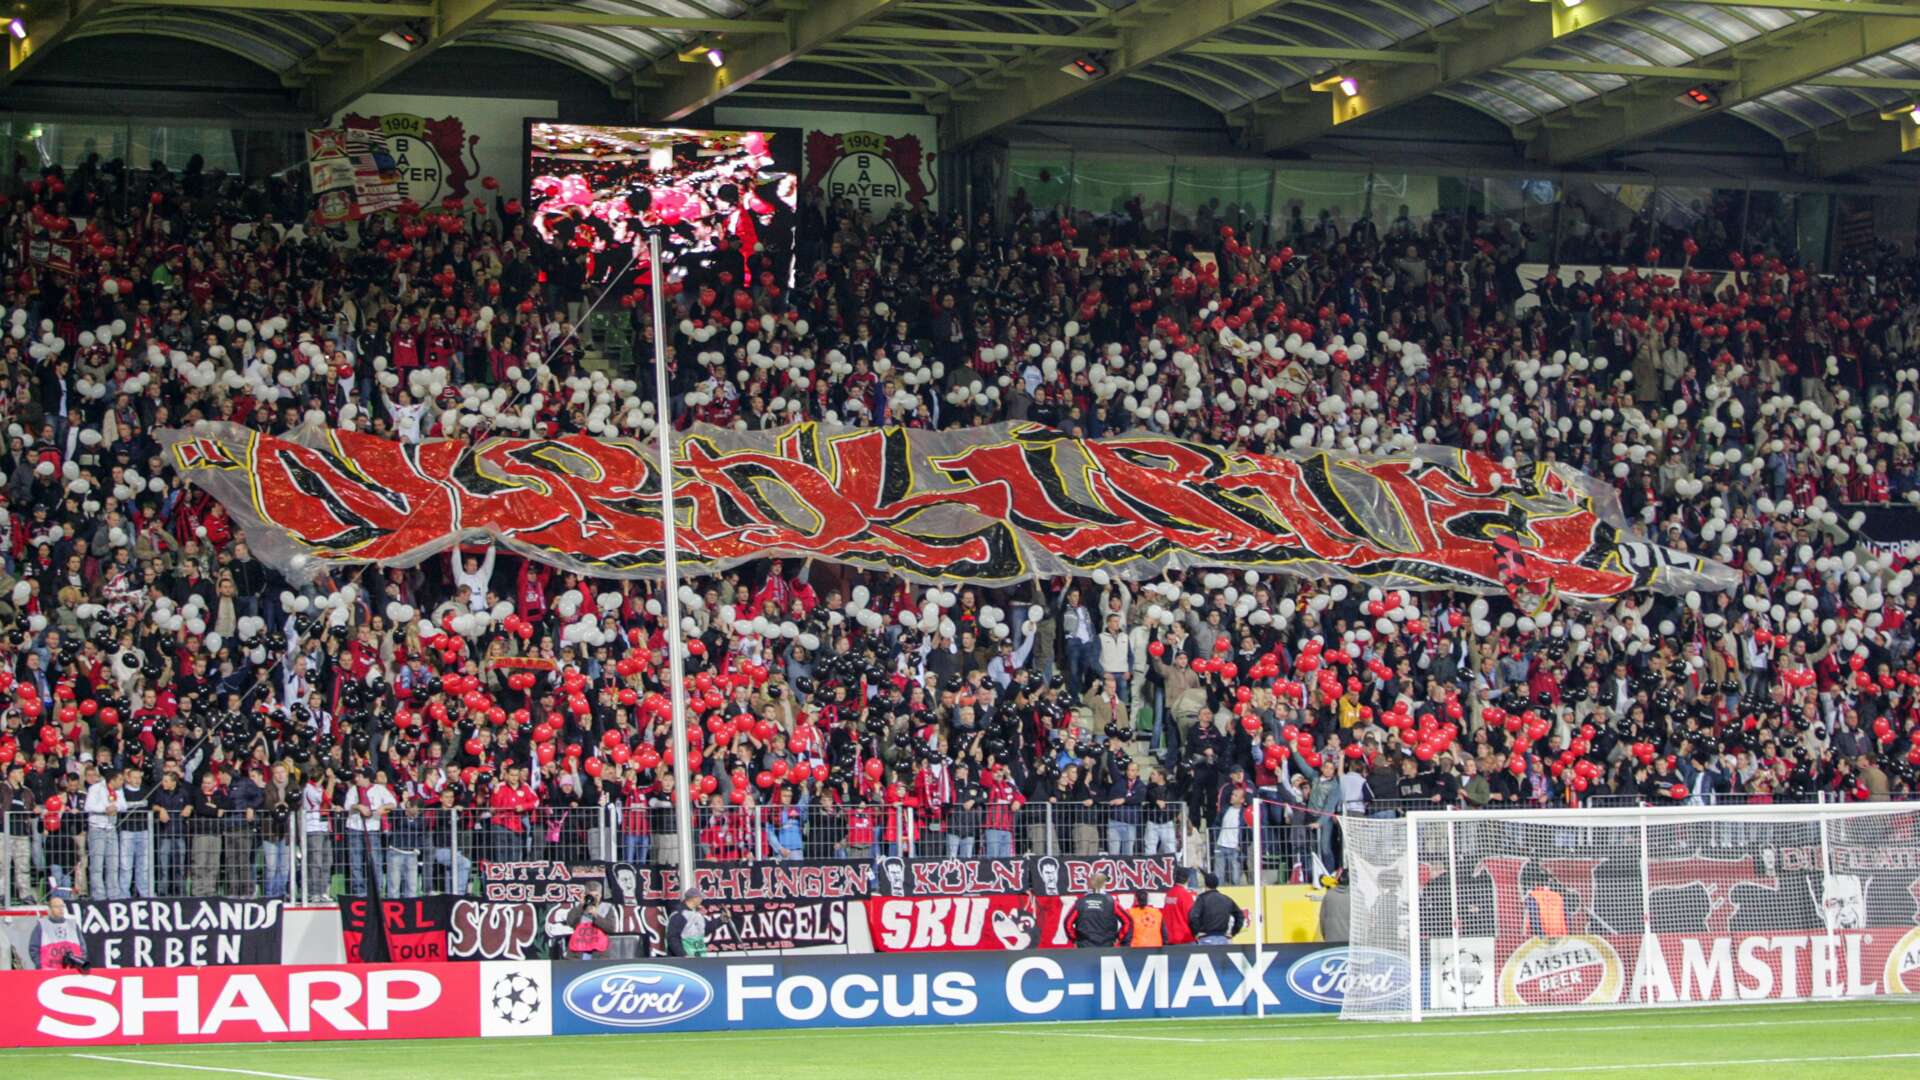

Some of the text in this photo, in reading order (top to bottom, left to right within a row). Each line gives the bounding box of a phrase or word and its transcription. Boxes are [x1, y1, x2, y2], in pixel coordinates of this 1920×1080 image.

[384, 118, 419, 132] 1904
[849, 135, 880, 148] 1904
[396, 139, 410, 198] BAYE
[398, 168, 437, 182] YER
[857, 155, 871, 213] BAYE
[832, 183, 896, 198] BAYER
[640, 864, 870, 899] LECHLINGEN
[913, 857, 1024, 894] KÖLN
[1065, 856, 1175, 892] BONN
[741, 901, 845, 944] ANGELS
[881, 897, 990, 949] SKU
[105, 935, 241, 969] ERBEN
[706, 940, 795, 952] ANCLUB
[1520, 947, 1595, 979] AMSTEL
[1006, 951, 1281, 1015] C-MAX
[1312, 957, 1395, 993] Ford
[1540, 970, 1582, 992] BEER
[1631, 933, 1878, 1002] AMSTEL
[36, 968, 442, 1039] SHARP
[591, 973, 684, 1015] Ford
